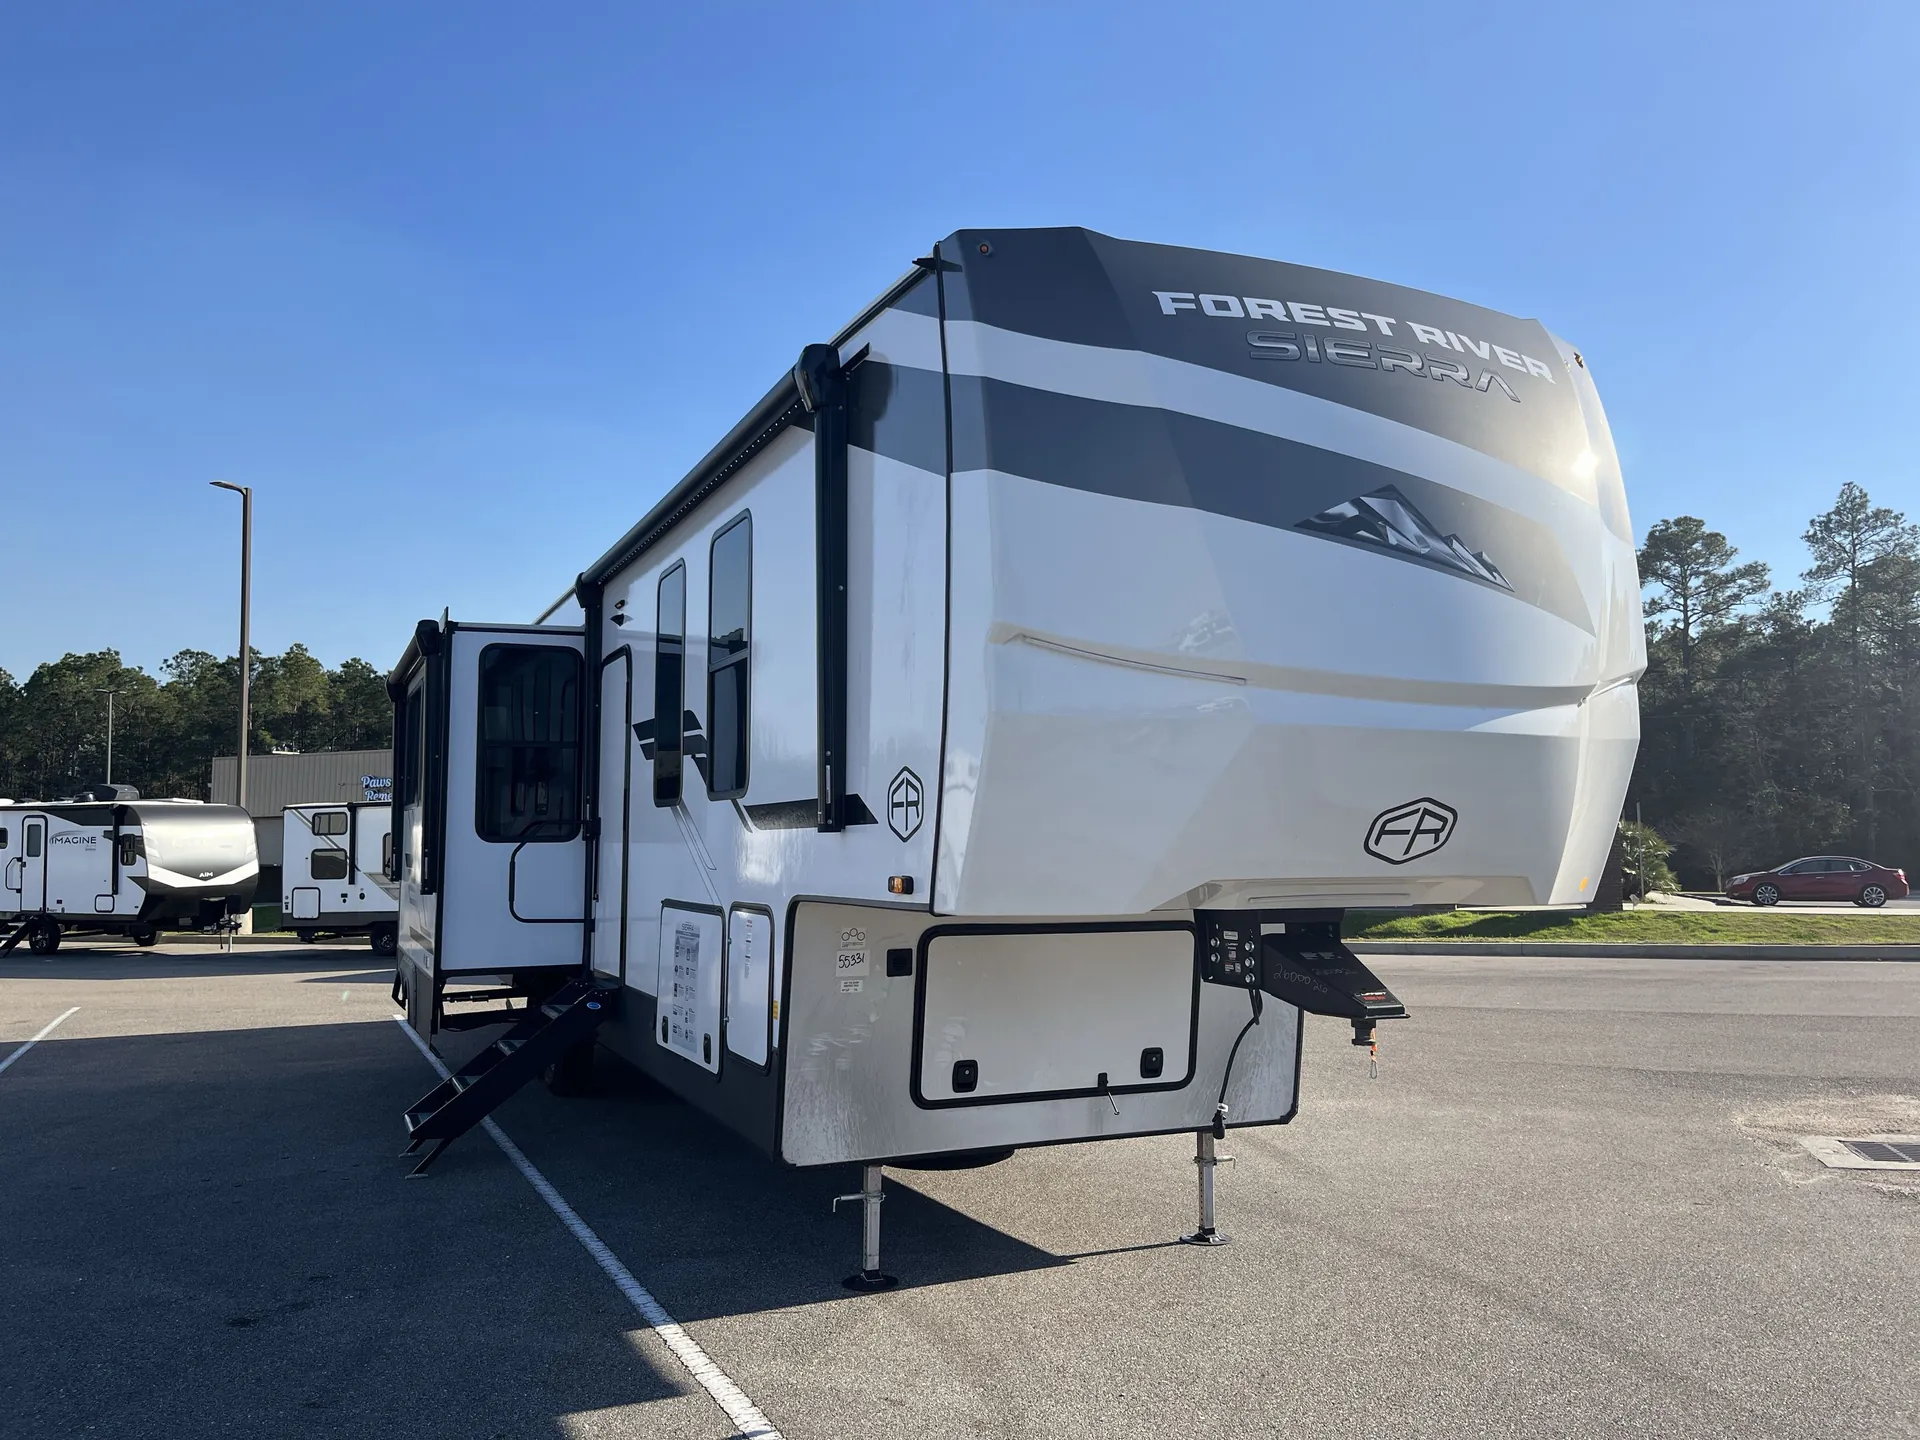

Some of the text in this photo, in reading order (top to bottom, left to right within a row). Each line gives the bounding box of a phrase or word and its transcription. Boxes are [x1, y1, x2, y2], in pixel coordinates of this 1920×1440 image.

[1151, 290, 1557, 385] FOREST RIVER
[1246, 329, 1521, 404] SIERRA
[361, 775, 392, 789] Paws
[51, 836, 97, 844] IMAGINE
[838, 952, 865, 969] 55331
